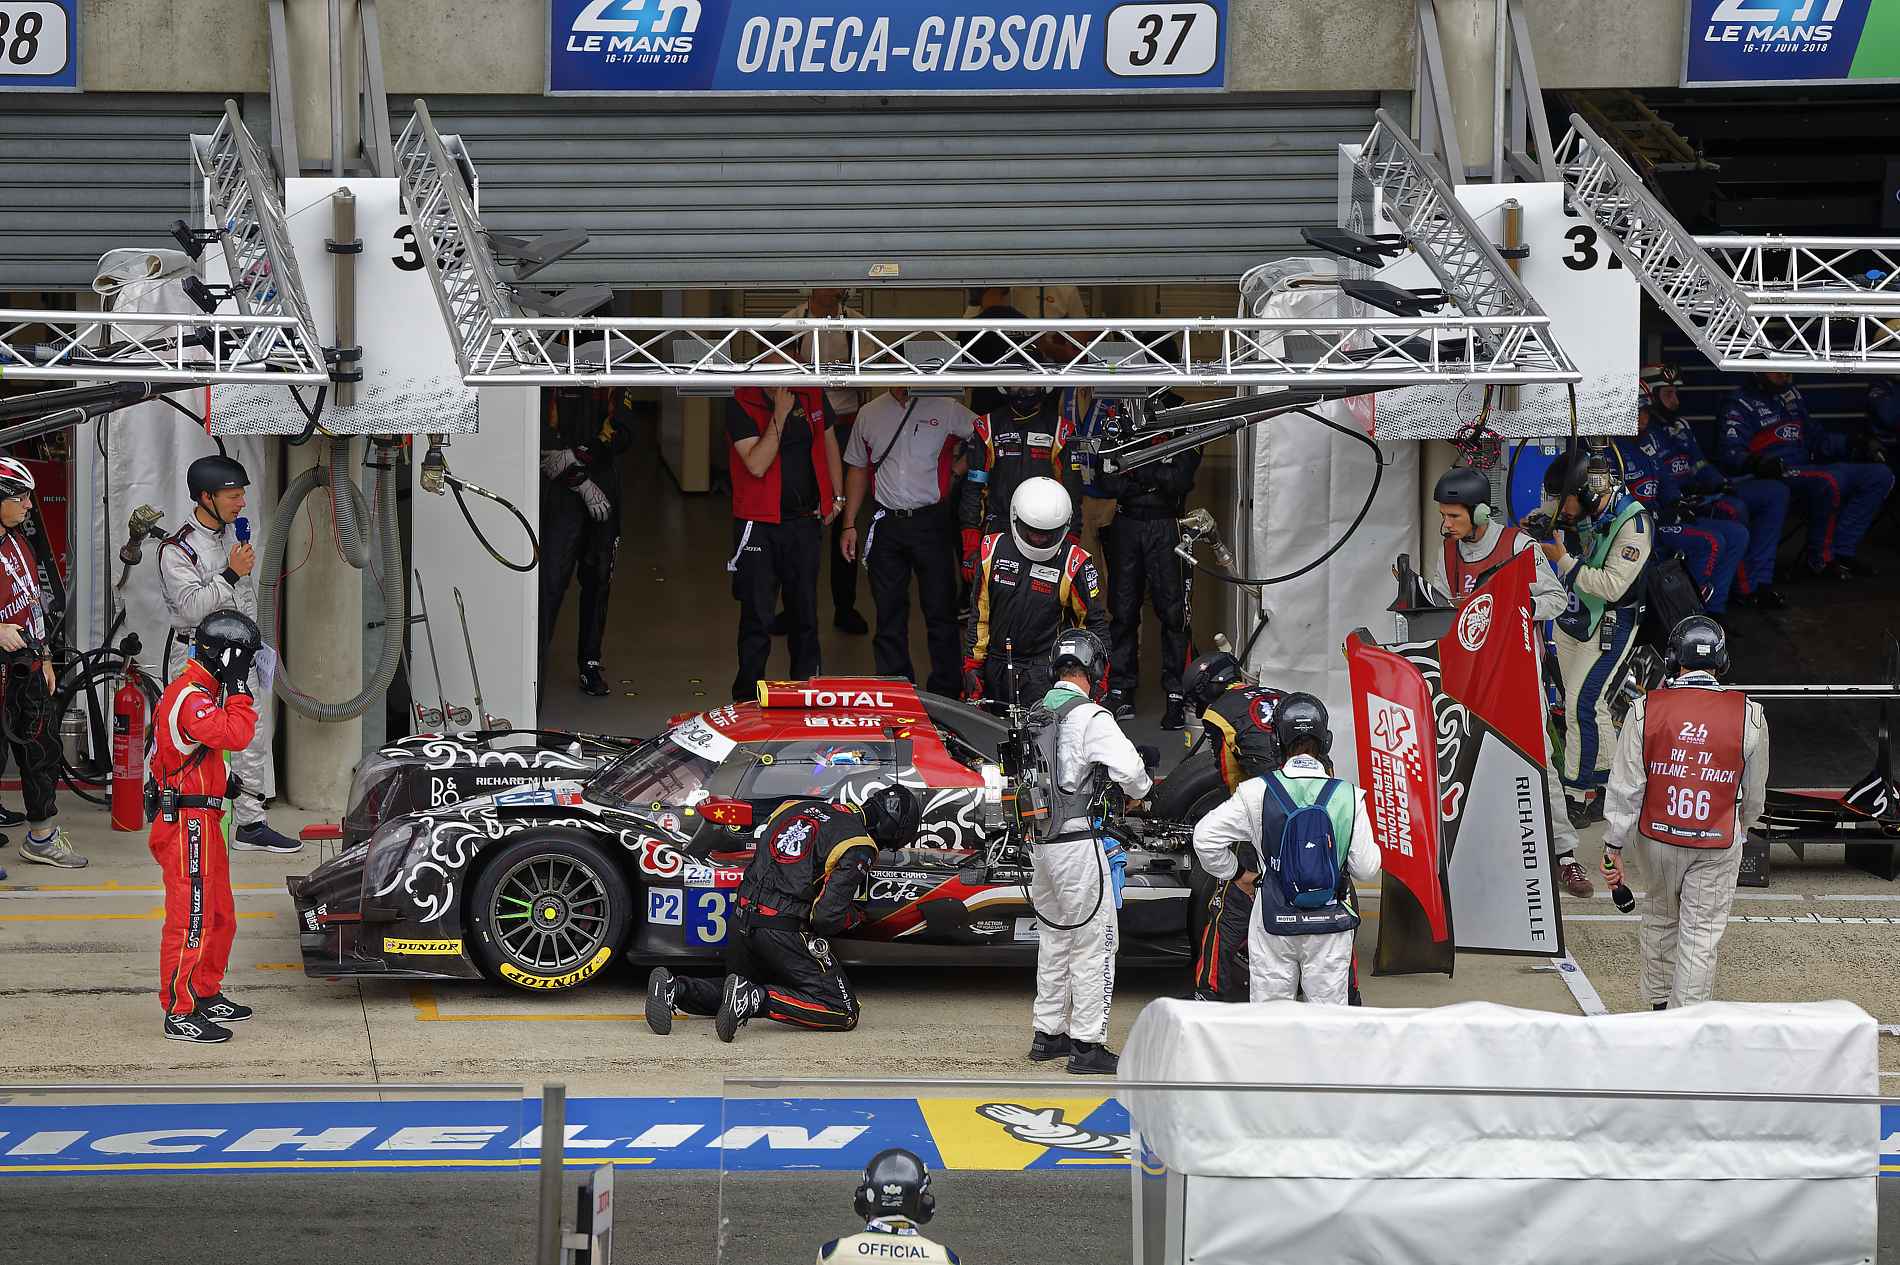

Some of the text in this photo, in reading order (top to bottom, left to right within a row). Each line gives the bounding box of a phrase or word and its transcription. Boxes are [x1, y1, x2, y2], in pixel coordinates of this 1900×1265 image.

[566, 35, 693, 52] LE MANS
[736, 13, 1197, 73] ORECA-GIBSON 37
[1704, 25, 1832, 42] LE MANS
[605, 54, 690, 63] 16-17 JUIN 2018
[1743, 43, 1828, 53] 16-17 JUIN 2018
[798, 690, 894, 707] TOTAL
[1671, 748, 1686, 762] RH
[1697, 751, 1712, 764] TV
[476, 777, 526, 786] RICHARD
[1651, 761, 1688, 778] ITLANE
[1700, 767, 1736, 783] TRACK
[1370, 750, 1389, 849] CIRCUIT
[1381, 754, 1399, 851] INTERNATIONAL
[1392, 758, 1414, 858] SEPANG
[1667, 785, 1711, 821] 366
[1516, 776, 1538, 870] RICHARD
[719, 871, 744, 881] TOT
[193, 885, 201, 914] JOTA
[869, 880, 920, 902] Café
[651, 892, 679, 920] P2
[697, 892, 737, 942] 3
[1525, 878, 1546, 942] MILLE
[397, 943, 459, 951] DUNLOP
[508, 962, 593, 988] DUNLOP
[0, 1125, 871, 1156] ICHELIN
[858, 1242, 930, 1258] OFFICIAL
